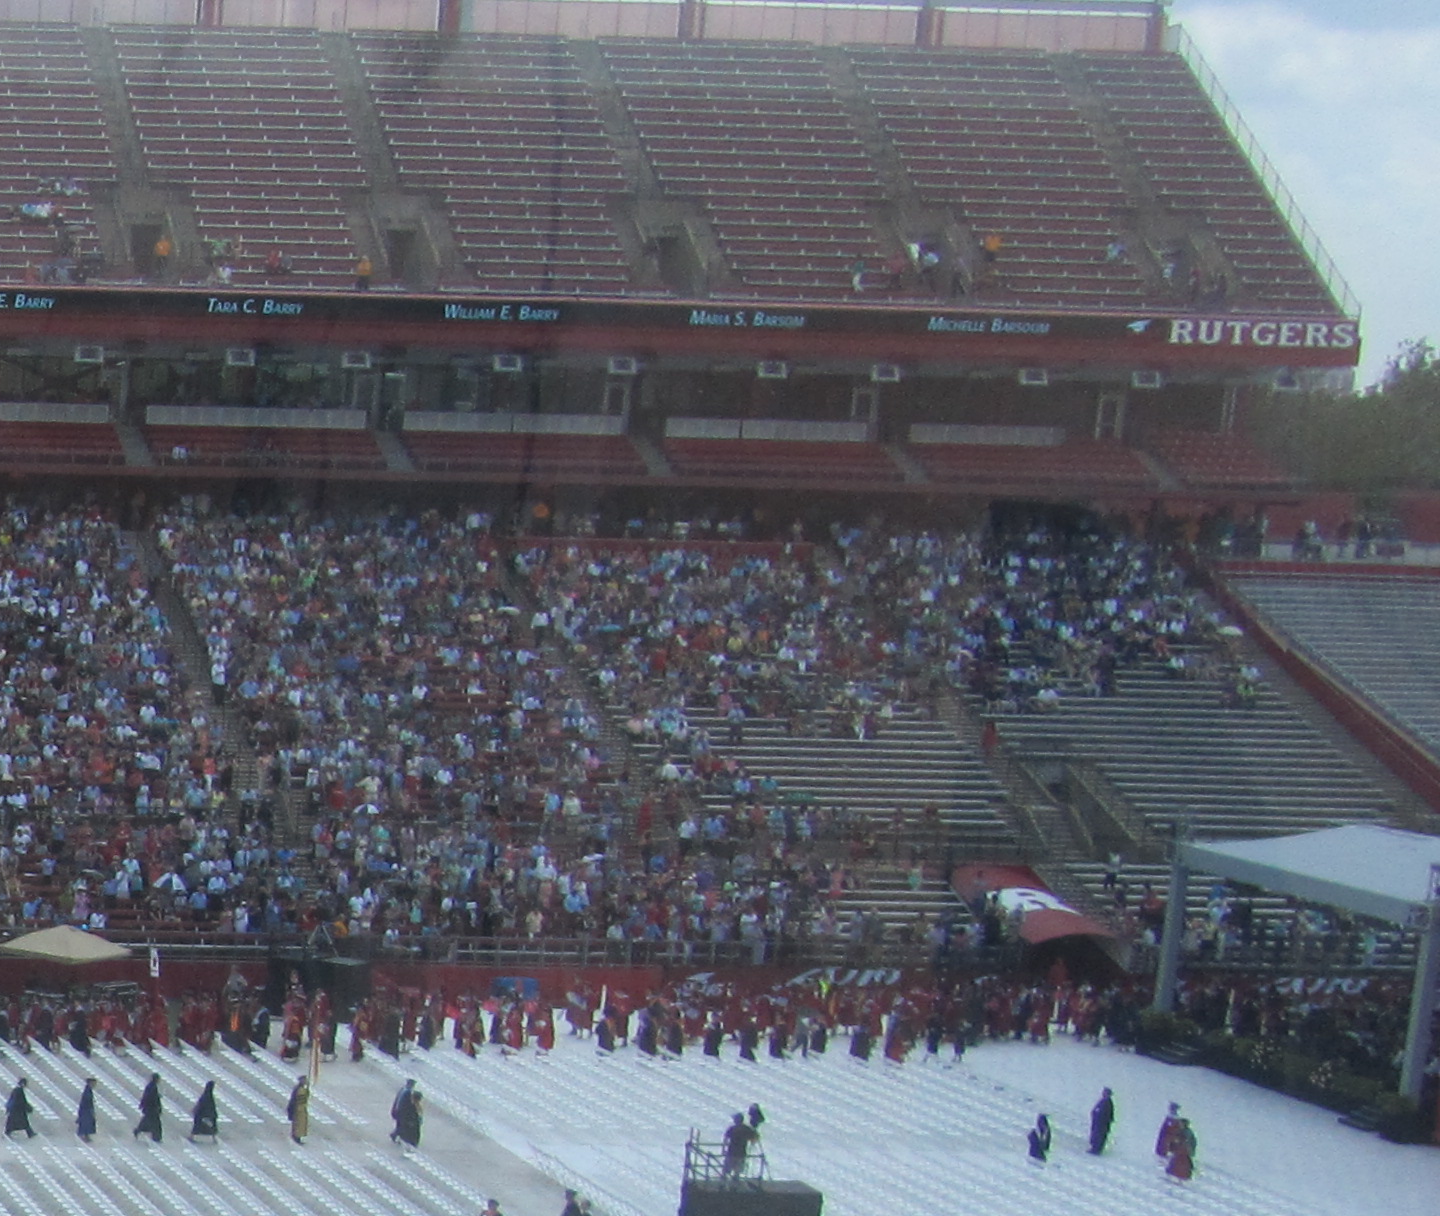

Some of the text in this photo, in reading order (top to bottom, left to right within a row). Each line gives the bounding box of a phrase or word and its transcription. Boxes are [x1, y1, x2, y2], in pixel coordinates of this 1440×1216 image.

[14, 294, 55, 310] BARRY
[207, 298, 238, 313] TARA
[263, 299, 304, 315] BARRY
[519, 305, 560, 321] BARRY
[1169, 319, 1355, 348] RUTGERS
